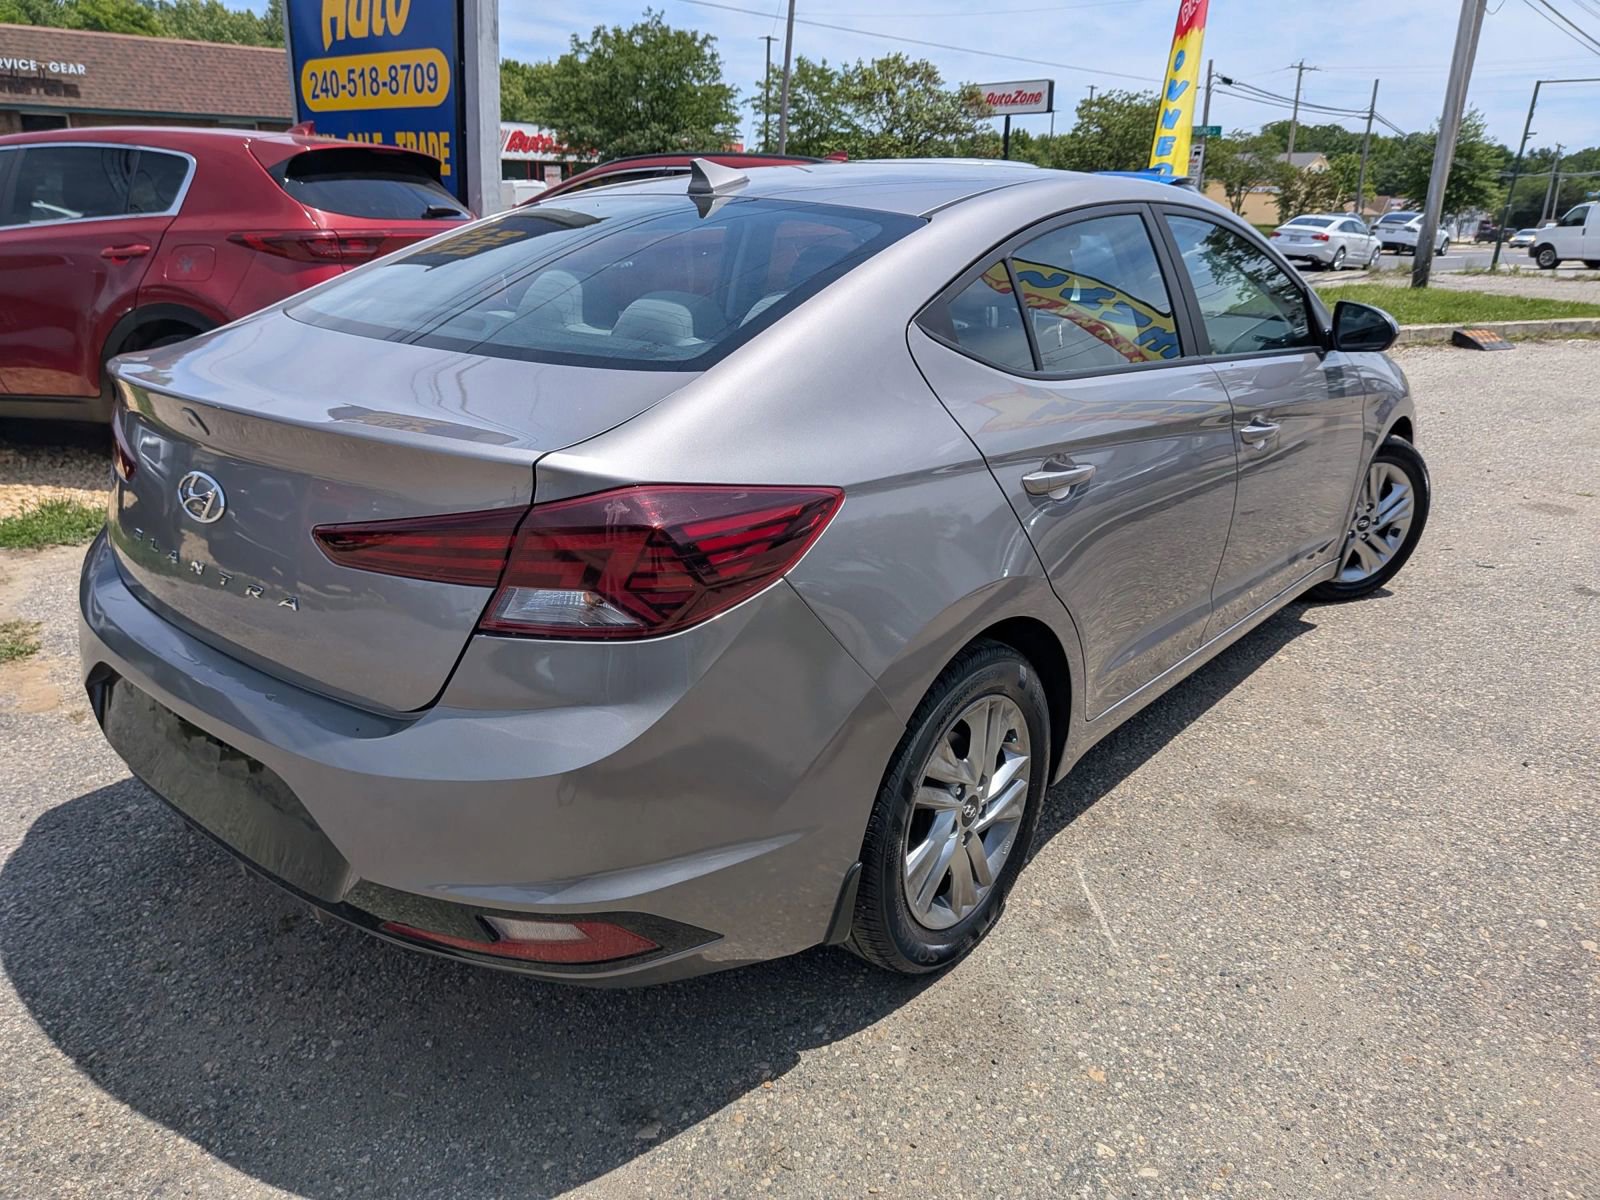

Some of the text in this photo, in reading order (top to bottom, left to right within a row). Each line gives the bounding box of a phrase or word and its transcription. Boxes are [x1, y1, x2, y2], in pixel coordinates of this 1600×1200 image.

[49, 61, 86, 75] GEAR
[310, 62, 438, 100] 240-518-8709
[985, 90, 1042, 106] AutoZone
[133, 527, 299, 611] ELANTRA
